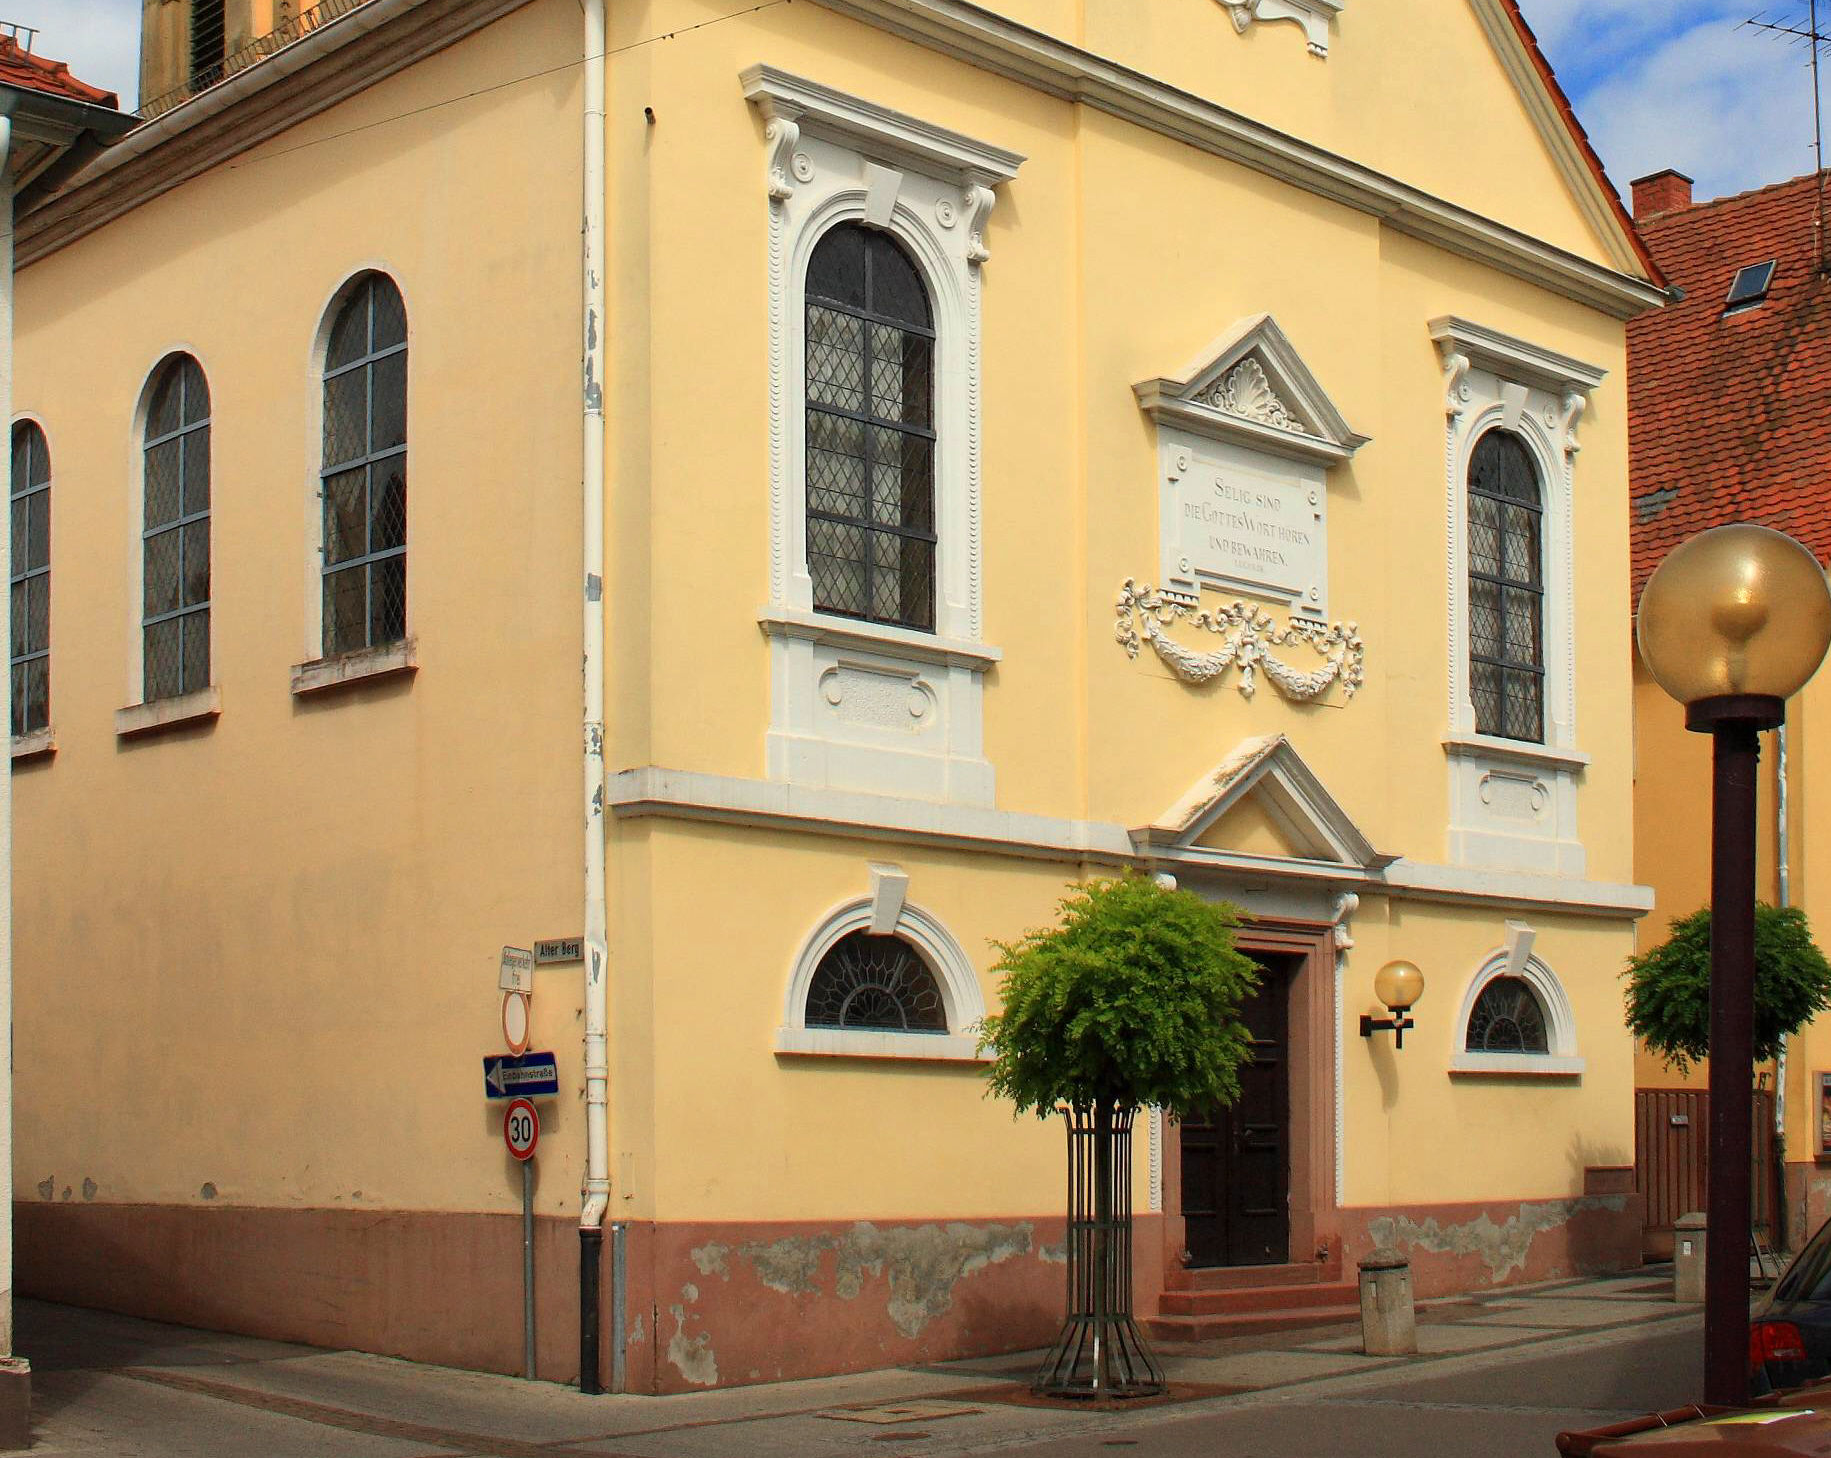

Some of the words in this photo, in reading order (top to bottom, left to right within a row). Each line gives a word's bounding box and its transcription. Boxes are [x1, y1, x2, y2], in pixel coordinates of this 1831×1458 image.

[1214, 476, 1251, 504] SELIG
[1255, 493, 1281, 512] SIND
[1184, 502, 1201, 520] DIE
[539, 943, 559, 958] Alter
[561, 941, 580, 958] Berg
[503, 1067, 553, 1080] Einbahnstraße
[510, 1115, 531, 1144] 30
